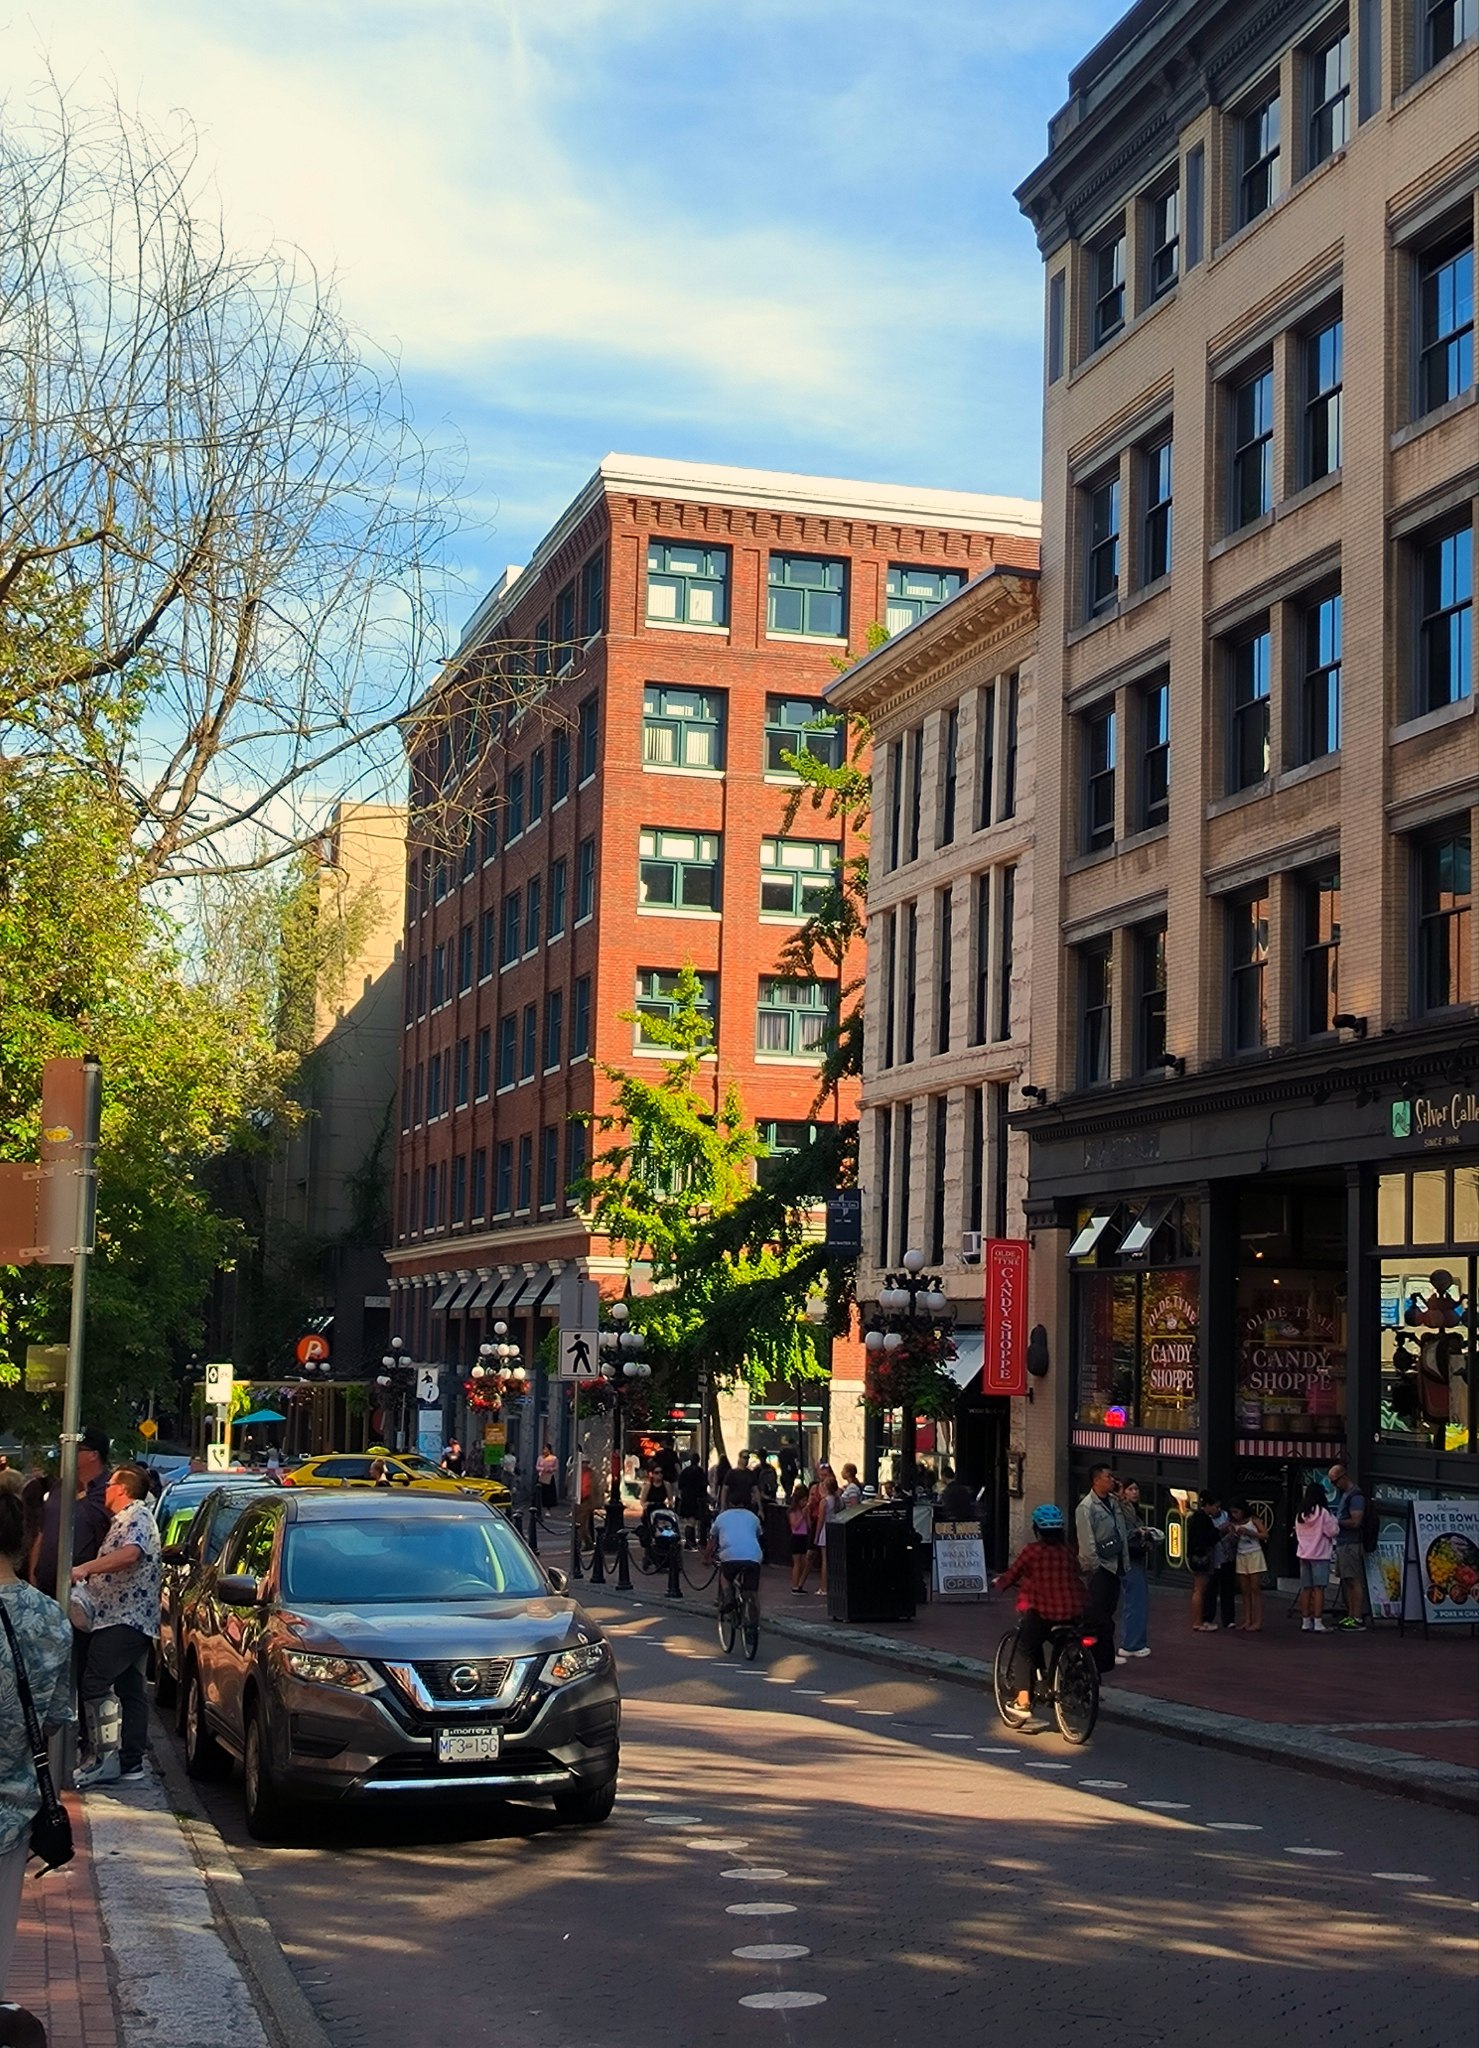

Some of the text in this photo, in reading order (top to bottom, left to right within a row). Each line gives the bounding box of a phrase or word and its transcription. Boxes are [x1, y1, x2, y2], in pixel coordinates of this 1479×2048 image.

[1415, 1098, 1449, 1134] Silver
[1001, 1267, 1014, 1317] CANDY
[1149, 1295, 1197, 1327] OLDE TYME
[1246, 1306, 1335, 1335] OLDE TYME
[1000, 1319, 1012, 1379] SHOPPE
[1151, 1344, 1193, 1363] CANDY
[1253, 1349, 1331, 1368] CANDY
[1150, 1368, 1194, 1389] SHOPPE
[1249, 1371, 1332, 1390] SHOPPE
[1418, 1513, 1447, 1522] POKE
[1420, 1524, 1448, 1532] POKE
[947, 1579, 980, 1588] OPEN
[453, 1728, 486, 1736] morrey
